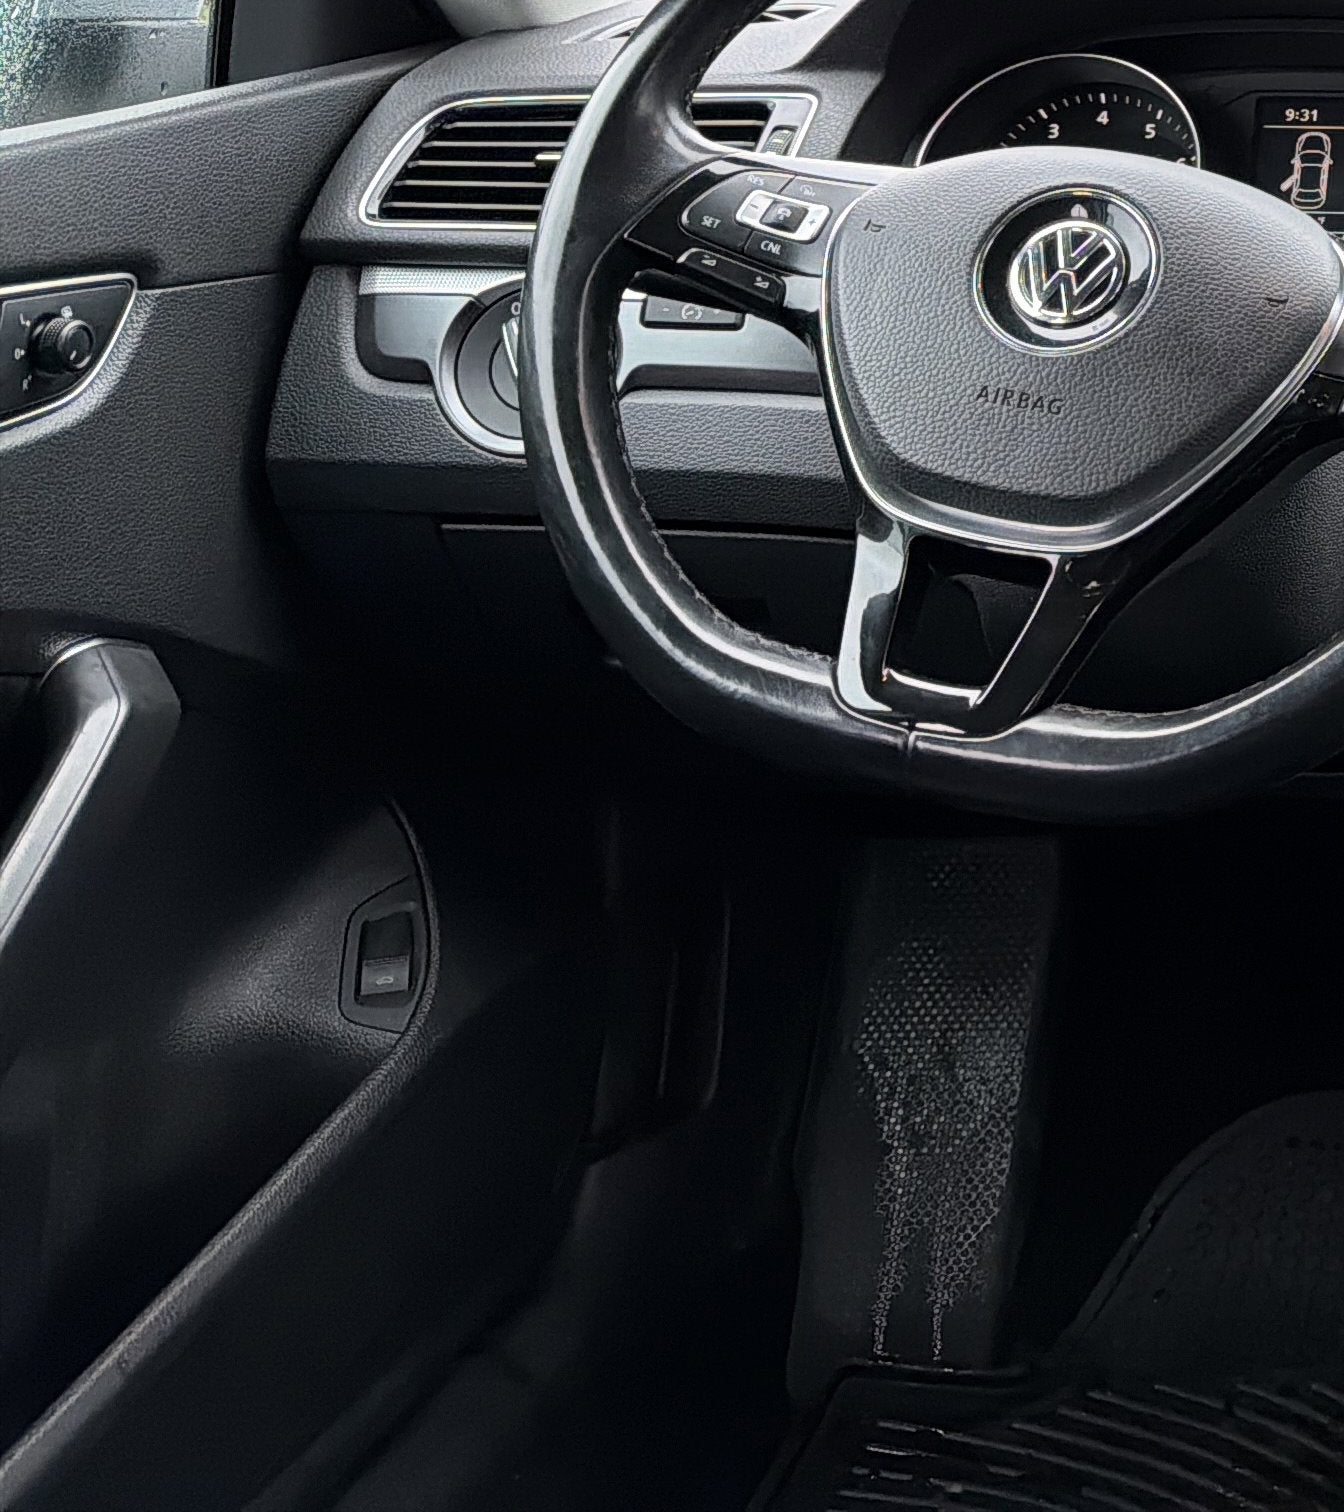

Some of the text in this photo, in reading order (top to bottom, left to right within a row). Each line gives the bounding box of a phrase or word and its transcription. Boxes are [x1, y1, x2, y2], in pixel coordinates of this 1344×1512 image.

[1096, 110, 1110, 126] 4
[1285, 108, 1318, 122] 9:31
[1047, 123, 1060, 139] 3
[1144, 124, 1156, 139] 5
[975, 385, 1065, 416] AIRBAG
